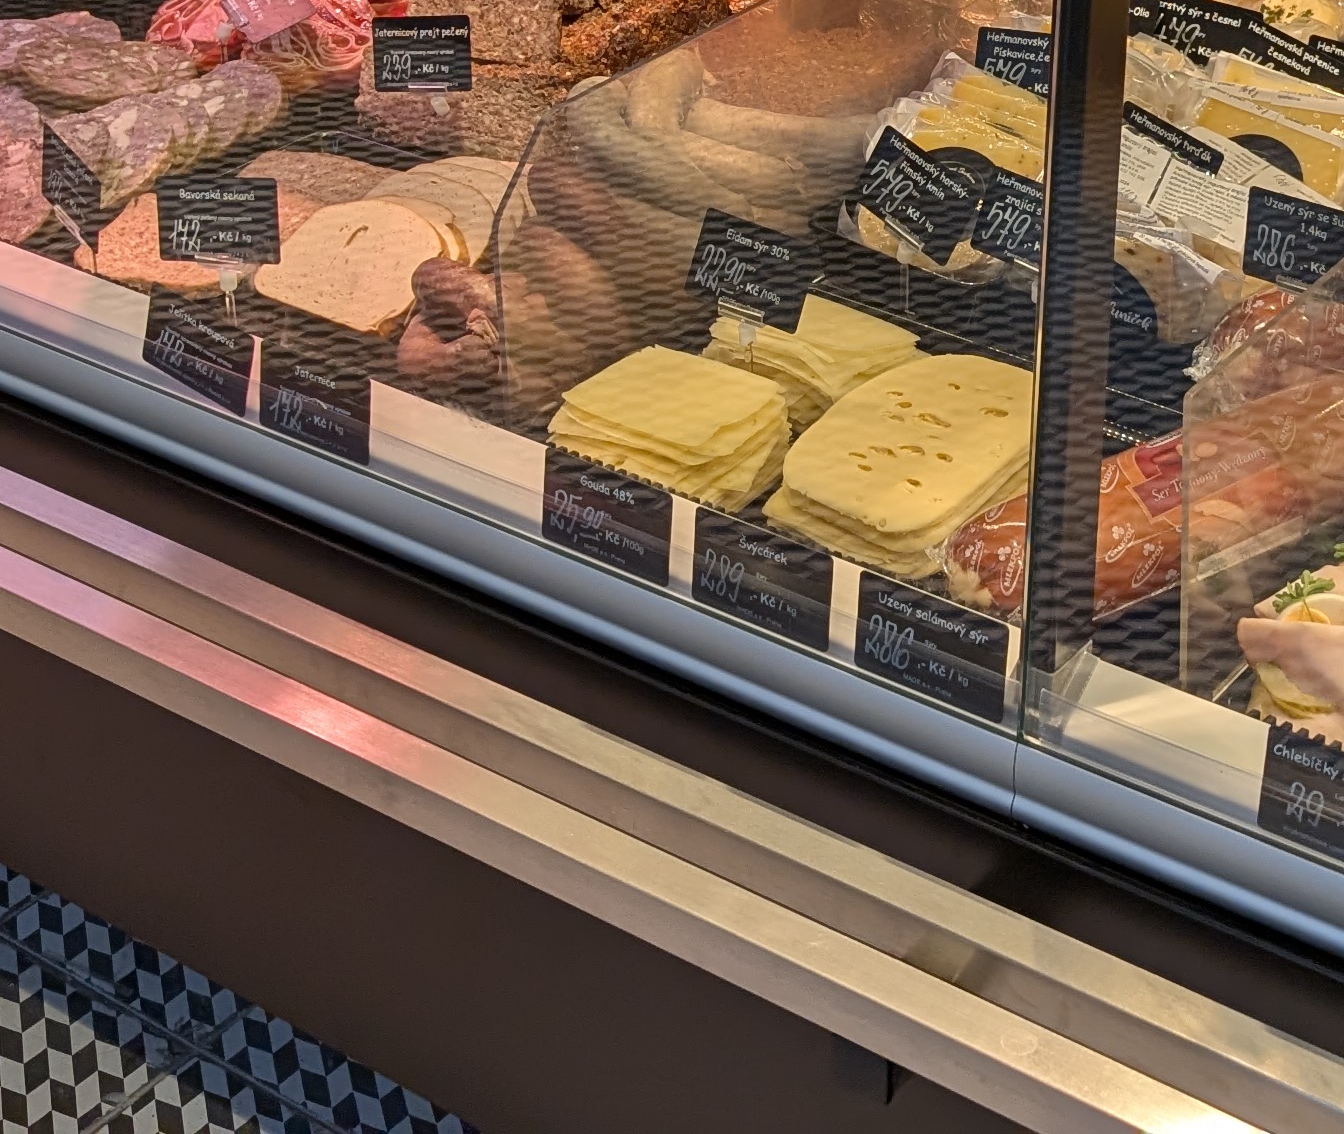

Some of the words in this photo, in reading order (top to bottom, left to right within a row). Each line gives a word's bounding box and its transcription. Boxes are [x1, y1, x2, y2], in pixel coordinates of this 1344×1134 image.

[986, 31, 1050, 49] Heřmanovský
[1130, 109, 1182, 148] Heřmanovský
[889, 133, 941, 179] Heřmanovský
[179, 188, 221, 201] Bavorská
[222, 191, 256, 202] sekaná
[1264, 195, 1296, 214] Uzený
[1298, 205, 1316, 221] sýr
[1317, 212, 1330, 225] se
[219, 231, 234, 242] Kč
[726, 228, 753, 248] Eidam
[753, 240, 769, 255] sýr
[770, 245, 790, 261] 30%
[294, 365, 337, 390] Jaternice
[580, 474, 610, 496] Gouda
[612, 487, 636, 506] 48%
[738, 533, 788, 566] Švýcárek
[760, 593, 776, 609] Kč
[878, 591, 913, 617] Uzený
[915, 609, 966, 638] salámový
[968, 629, 989, 645] sýr
[929, 660, 946, 678] Kč
[1273, 743, 1340, 781] Chlebíčky
